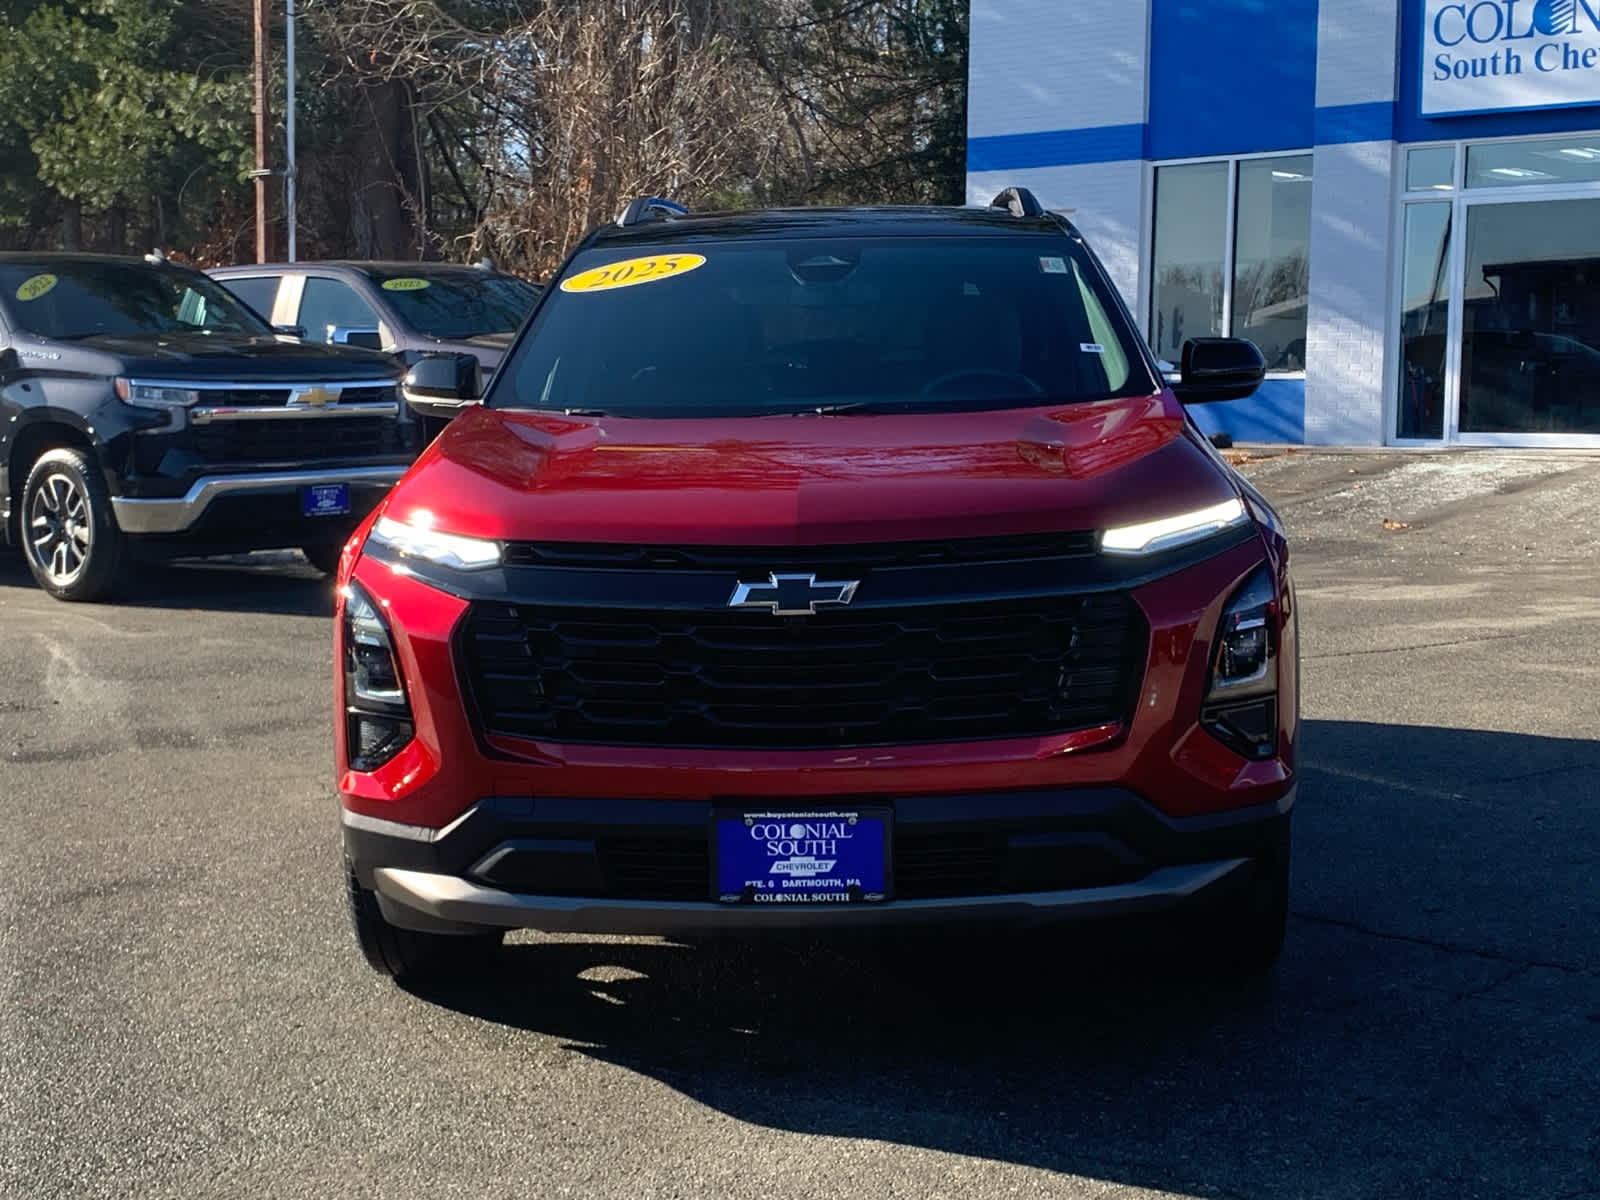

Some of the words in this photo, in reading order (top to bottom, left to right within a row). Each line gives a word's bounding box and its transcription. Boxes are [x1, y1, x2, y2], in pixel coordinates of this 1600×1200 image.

[1434, 48, 1522, 81] South
[1535, 42, 1600, 72] Che
[588, 256, 683, 288] 2025
[743, 812, 859, 820] www.buycolonialsouth.com
[751, 823, 853, 840] COLONIAL
[767, 840, 837, 856] SOUTH
[776, 862, 830, 872] CHEVROLET
[768, 880, 775, 888] 6
[782, 879, 844, 888] DARTMOUTH,
[754, 893, 811, 903] COLONIAL
[812, 892, 850, 902] SOUTH
